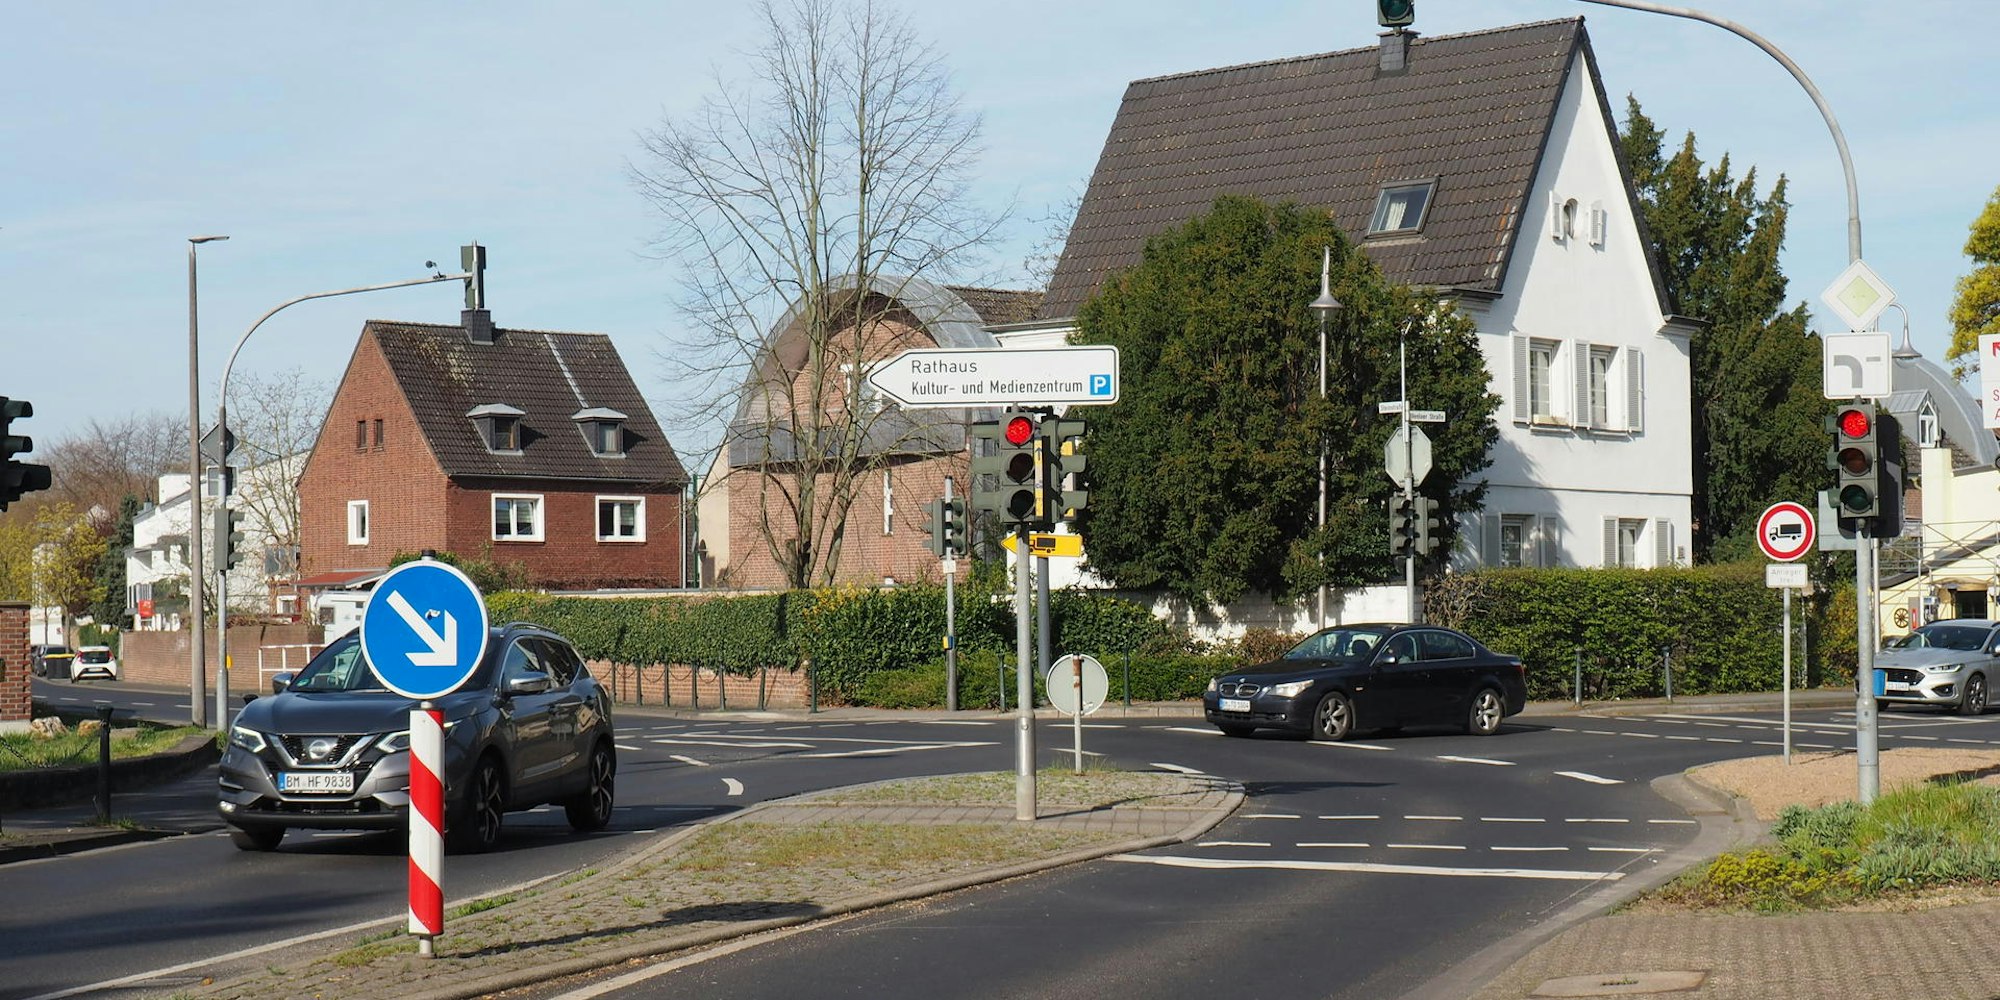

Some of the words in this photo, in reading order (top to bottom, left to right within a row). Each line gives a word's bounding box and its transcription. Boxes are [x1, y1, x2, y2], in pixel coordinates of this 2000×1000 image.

[911, 360, 977, 374] Rathaus
[911, 381, 955, 395] Kultur-
[962, 381, 983, 394] und
[990, 380, 1083, 394] Medienzentrum
[1094, 376, 1106, 393] P
[286, 776, 300, 788] BM
[308, 776, 321, 788] HF
[324, 776, 351, 788] 9838
